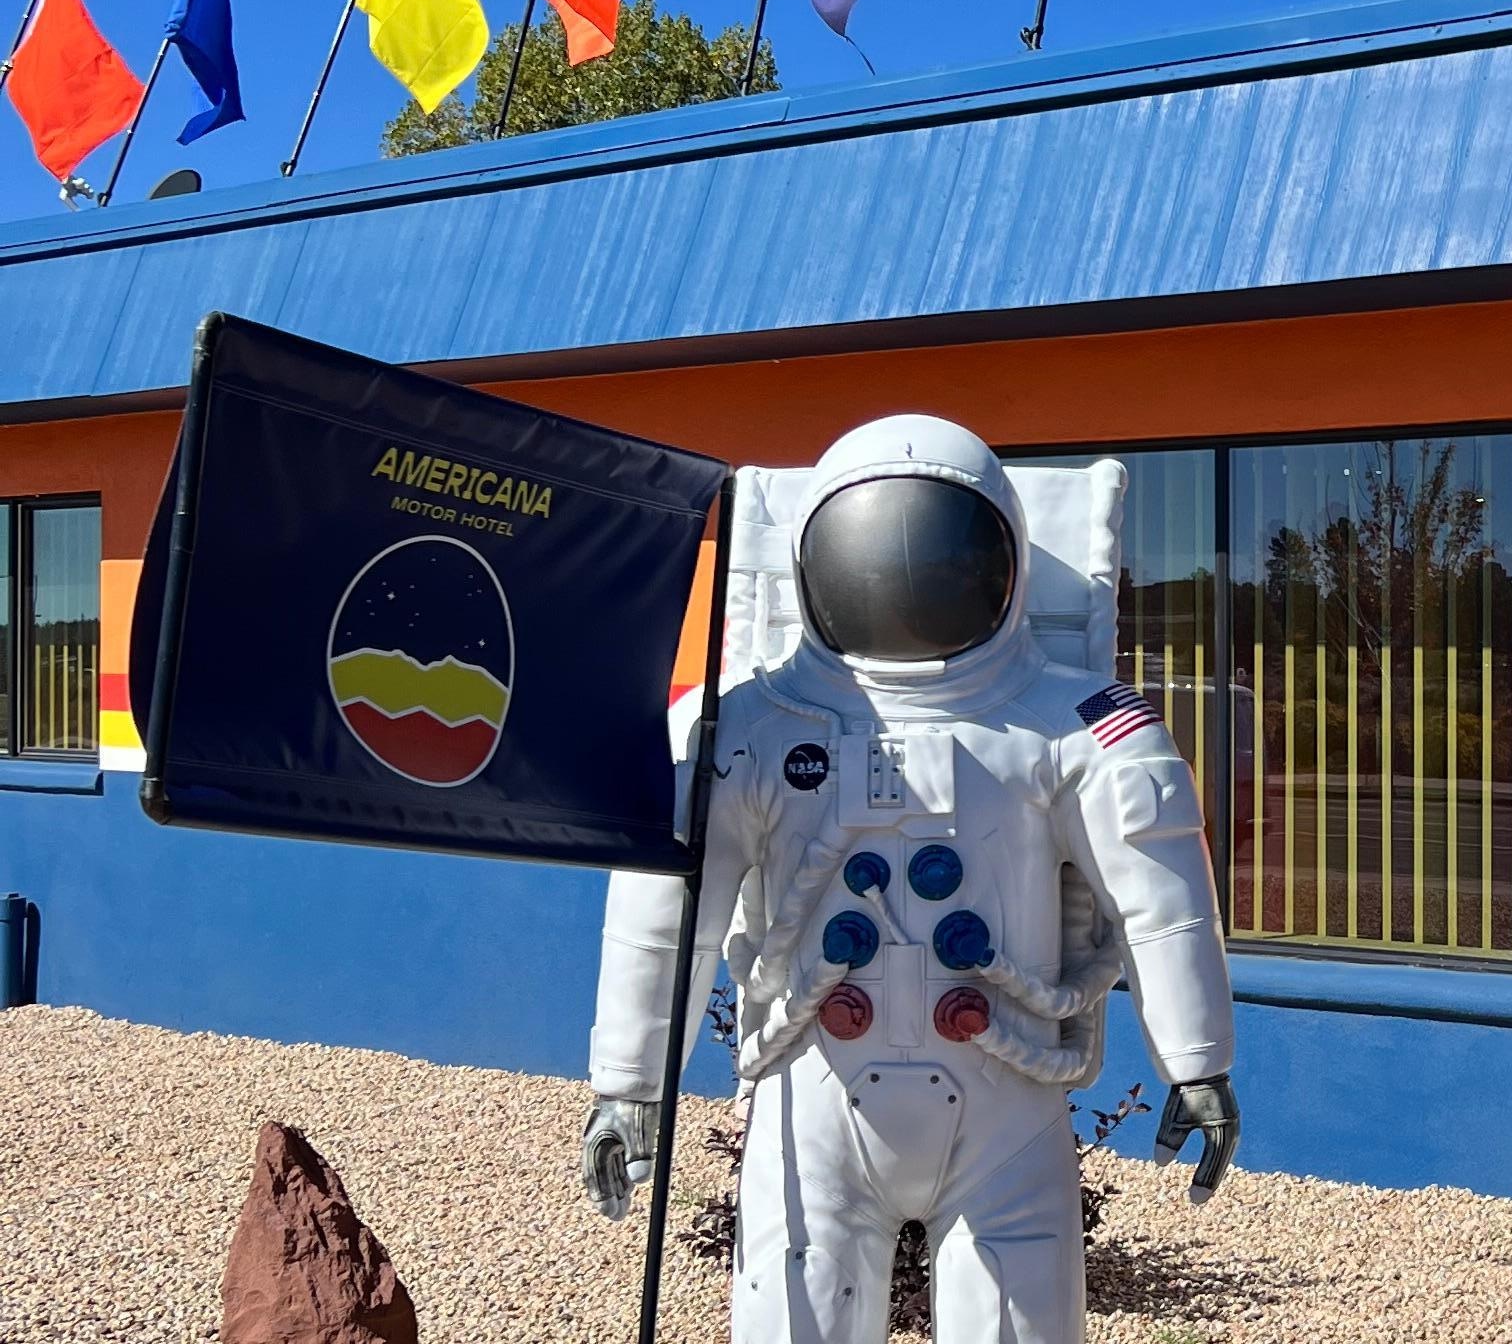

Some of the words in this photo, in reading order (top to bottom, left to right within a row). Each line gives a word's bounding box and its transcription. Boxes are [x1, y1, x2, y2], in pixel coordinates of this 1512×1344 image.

[371, 447, 552, 518] AMERICANA
[391, 496, 457, 523] MOTOR
[460, 512, 515, 537] HOTEL
[788, 761, 825, 774] NASA
